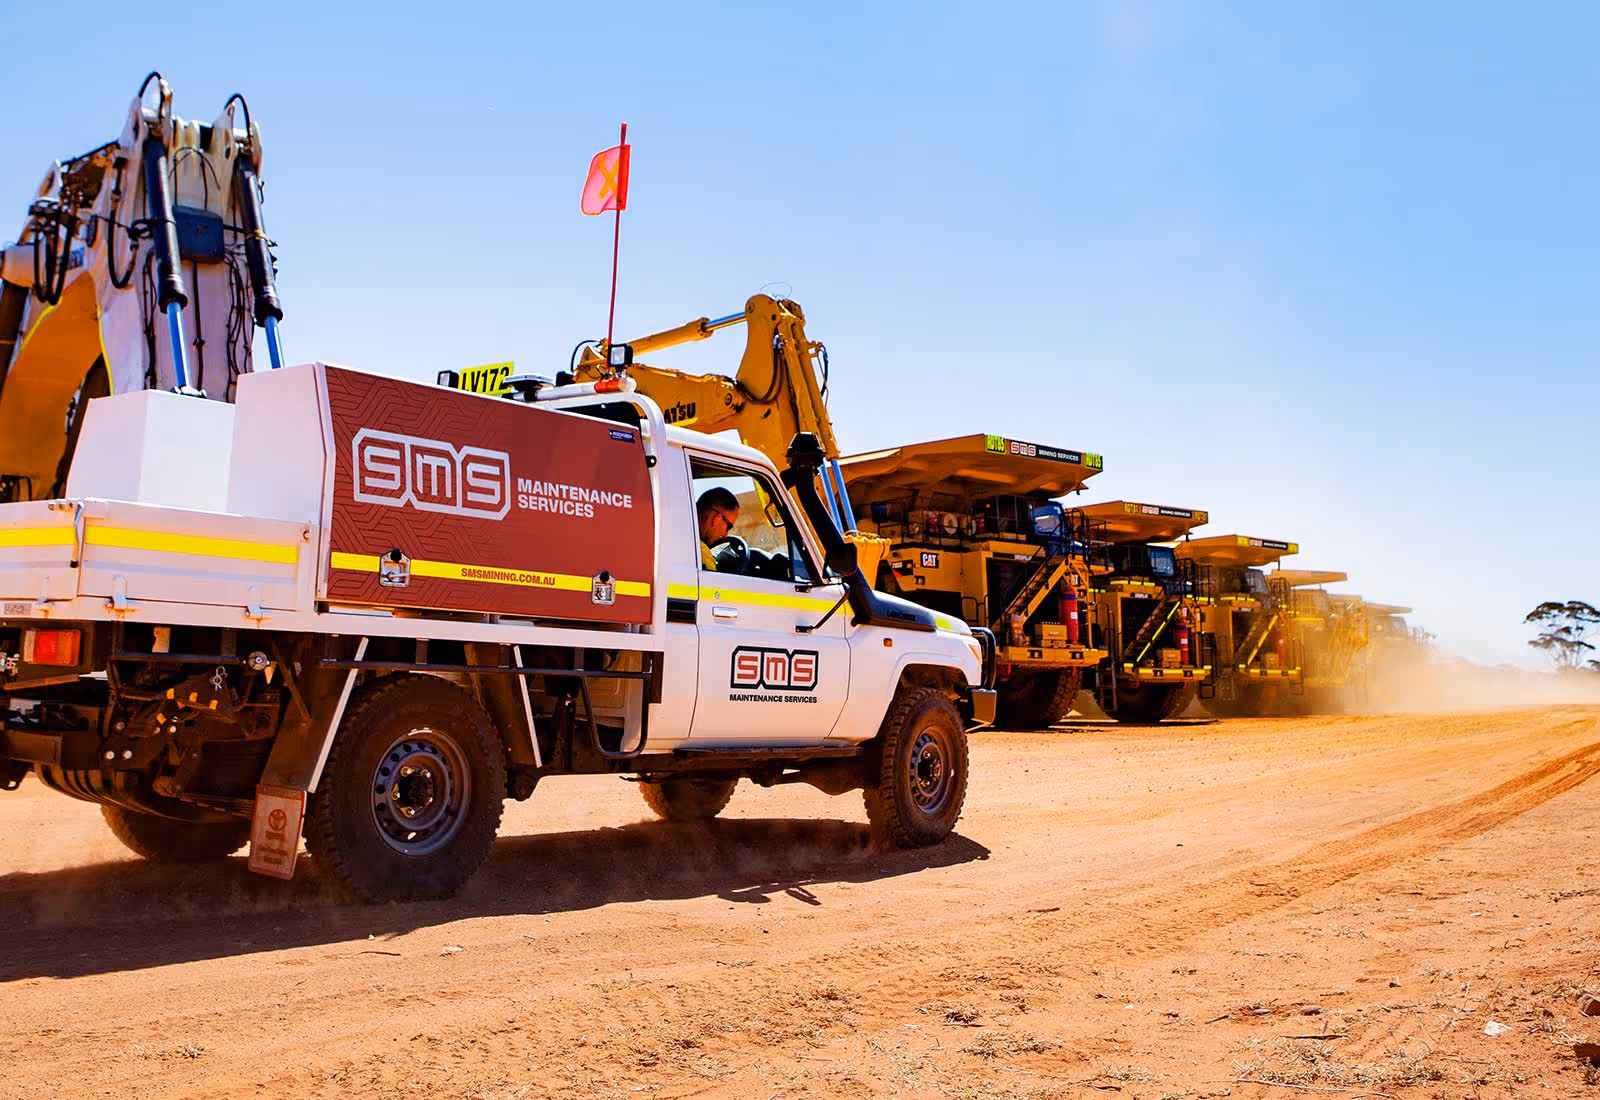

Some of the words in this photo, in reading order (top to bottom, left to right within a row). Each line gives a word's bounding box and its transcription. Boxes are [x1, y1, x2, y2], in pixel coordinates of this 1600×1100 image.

[461, 367, 510, 392] LV172
[663, 401, 696, 424] ATSU
[1038, 449, 1057, 458] MINING
[1057, 452, 1079, 462] SERVICES
[517, 478, 633, 509] MAINTENANCE
[517, 493, 595, 519] SERVICES
[922, 553, 937, 567] CAT
[460, 566, 556, 587] SMSMINING.COM.AU
[729, 694, 783, 703] MAINTENANCE
[784, 696, 818, 704] SERVICES
